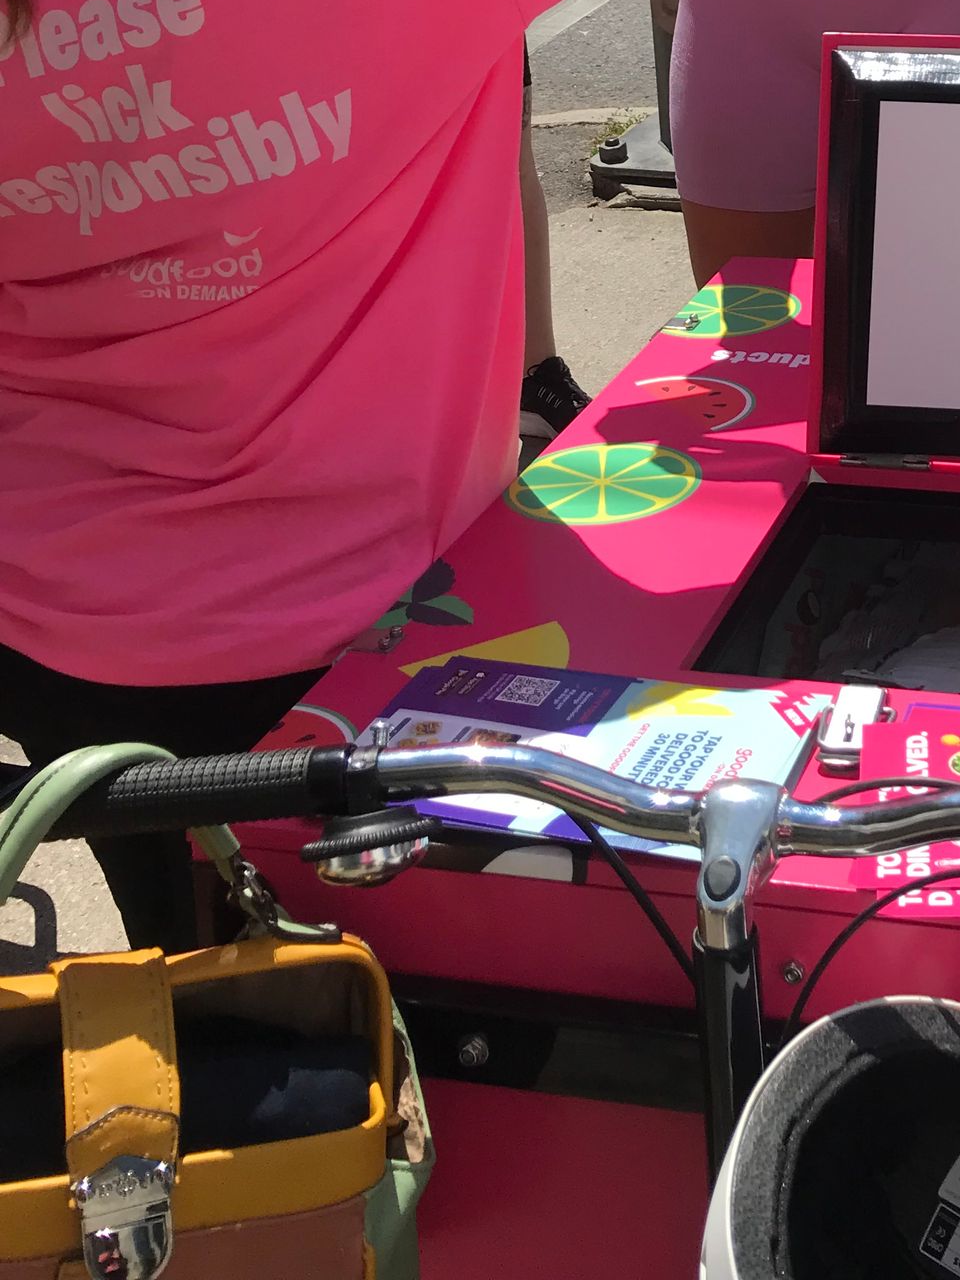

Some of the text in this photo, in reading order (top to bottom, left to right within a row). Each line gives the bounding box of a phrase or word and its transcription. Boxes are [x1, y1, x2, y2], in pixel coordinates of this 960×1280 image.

[41, 64, 194, 144] lick
[653, 732, 671, 746] 30
[691, 729, 709, 743] TO
[703, 735, 722, 754] TAP
[640, 732, 689, 786] DELIVERED
[667, 743, 698, 775] GOOD
[679, 754, 710, 782] YOUR
[722, 748, 753, 780] good
